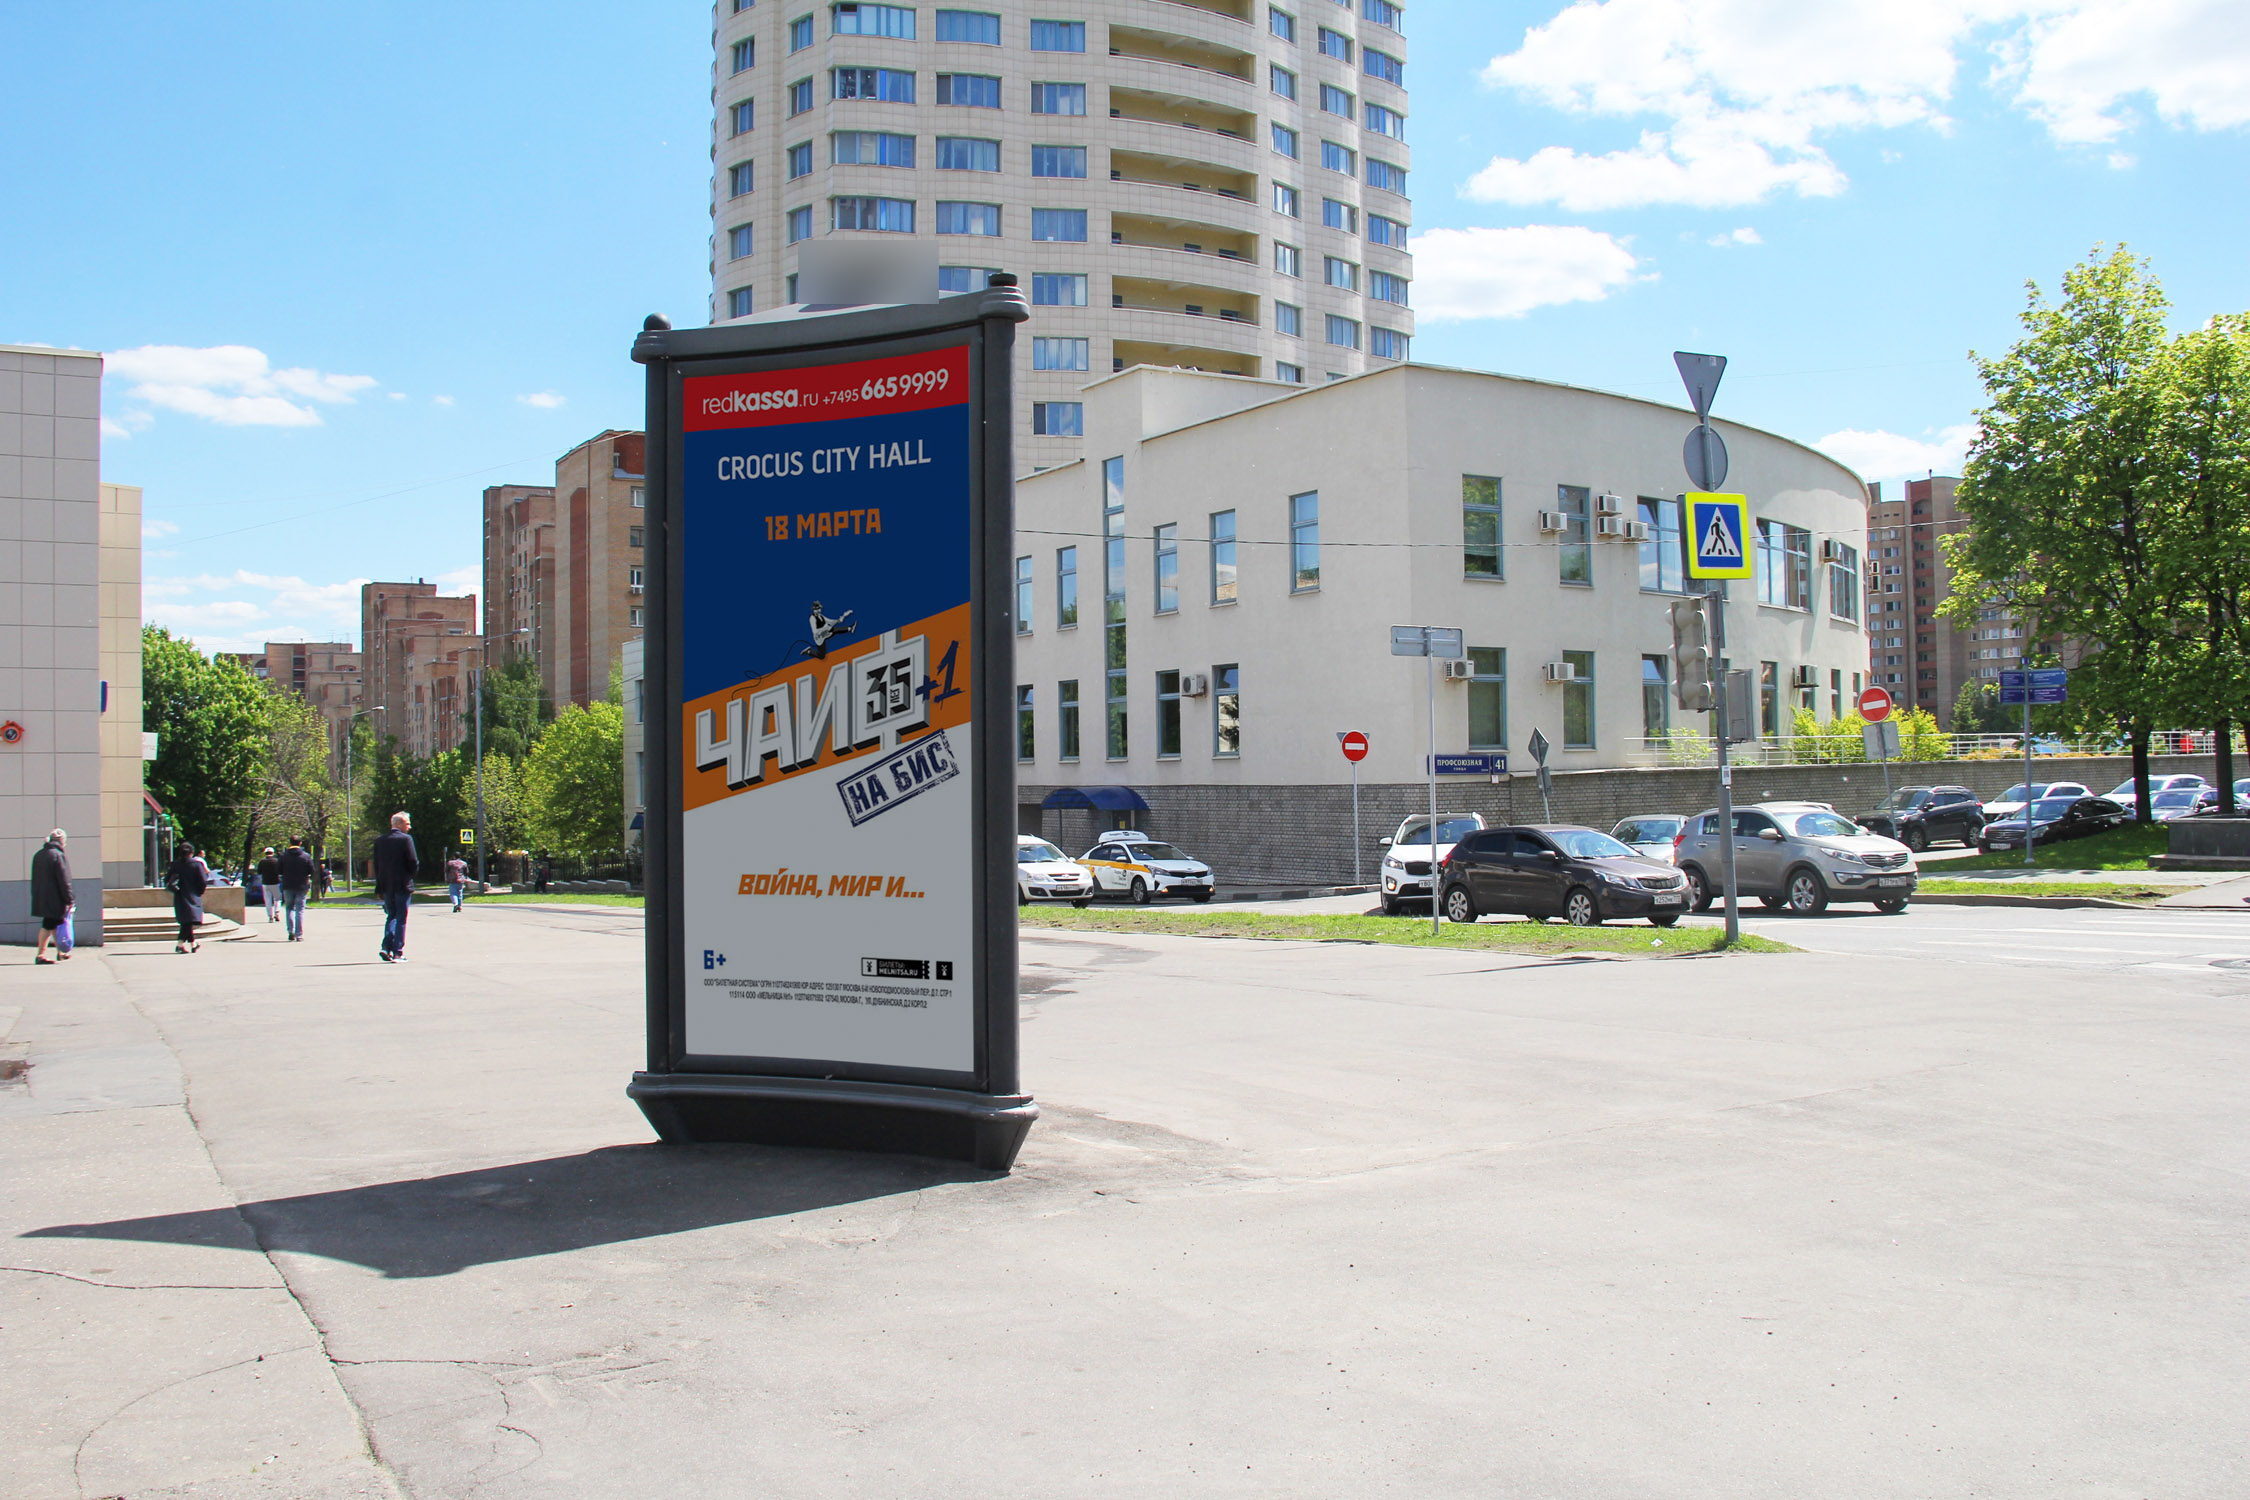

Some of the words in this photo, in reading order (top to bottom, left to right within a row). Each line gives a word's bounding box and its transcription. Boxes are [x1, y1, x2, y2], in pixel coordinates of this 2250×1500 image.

[702, 388, 819, 414] redkassa.ru
[717, 450, 804, 481] CROCUS
[812, 446, 861, 474] CITY
[869, 439, 932, 469] HALL
[765, 514, 789, 541] 18
[796, 507, 882, 539] МАРТА
[1436, 759, 1483, 767] ПРОФСОЮЗНАЯ
[1495, 759, 1505, 770] 41
[848, 773, 889, 816] НА
[888, 740, 949, 793] БИС
[738, 867, 823, 899] ВОЙНА,
[828, 874, 884, 897] МИР
[703, 949, 727, 970] 6+
